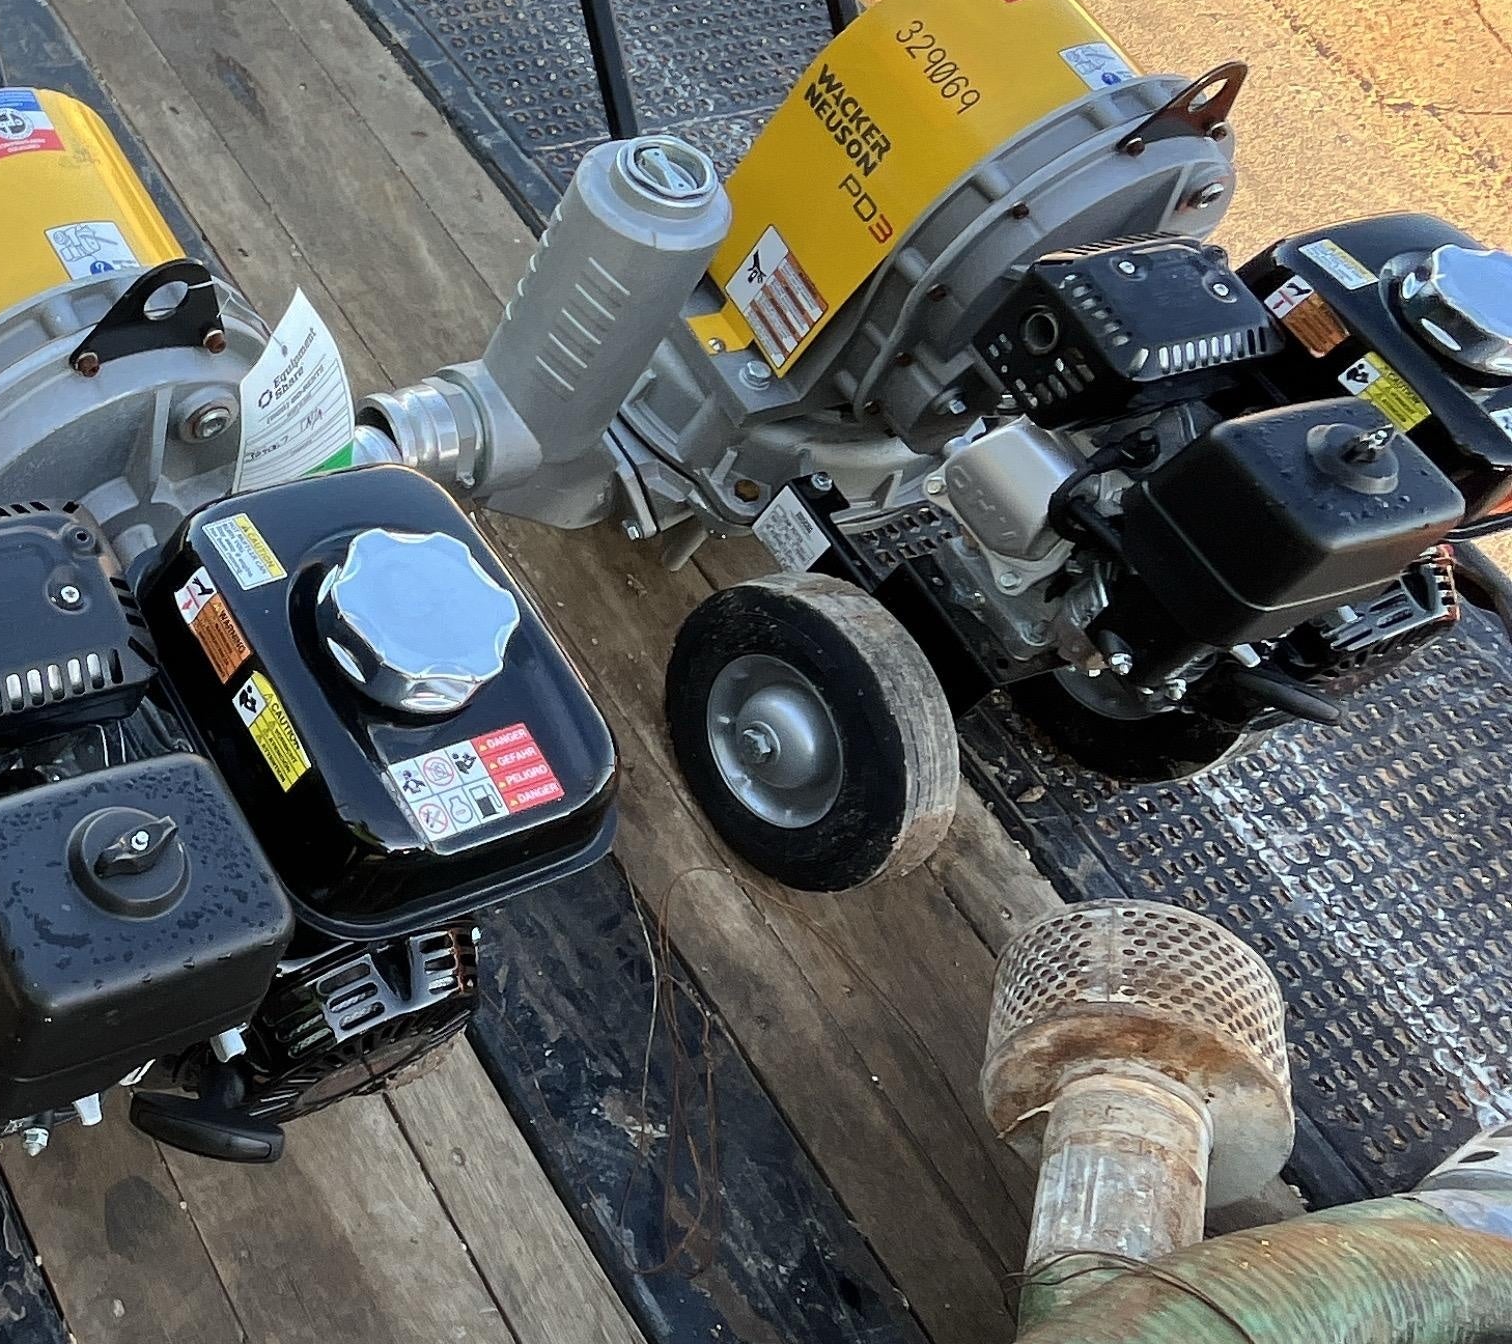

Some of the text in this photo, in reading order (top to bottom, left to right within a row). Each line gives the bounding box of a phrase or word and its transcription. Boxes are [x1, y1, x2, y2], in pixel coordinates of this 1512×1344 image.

[895, 20, 981, 115] 329069
[804, 82, 878, 177] NEUSON
[817, 63, 892, 163] WACKER
[838, 173, 894, 244] PD3
[273, 327, 317, 390] Equipment
[248, 532, 275, 568] CAUTION
[219, 610, 246, 654] WARNING
[271, 702, 300, 750] CAUTION
[486, 728, 527, 749] DANGER
[496, 746, 538, 766] GEFAHR
[505, 764, 548, 785] PELIGRO
[516, 782, 561, 803] DANGER
